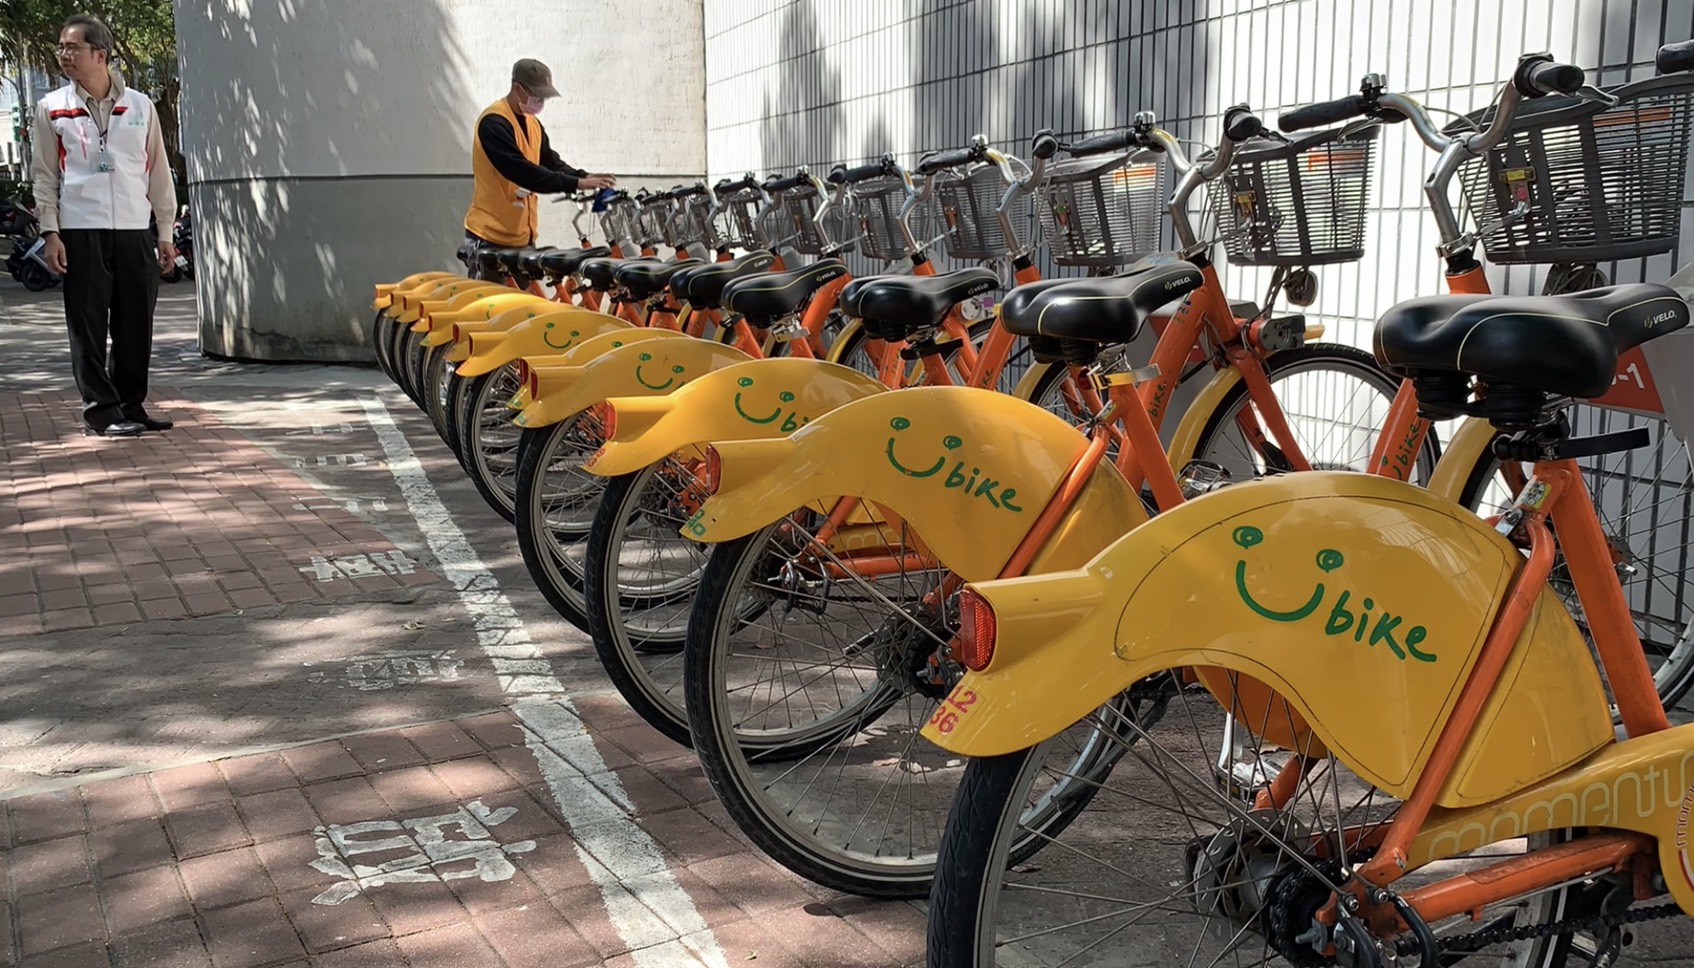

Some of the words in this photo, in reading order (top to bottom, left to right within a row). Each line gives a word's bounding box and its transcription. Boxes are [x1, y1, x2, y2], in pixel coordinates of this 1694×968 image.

[1172, 276, 1191, 287] VELO
[1652, 310, 1675, 325] VELO
[1611, 363, 1645, 389] -1
[947, 684, 977, 713] 12
